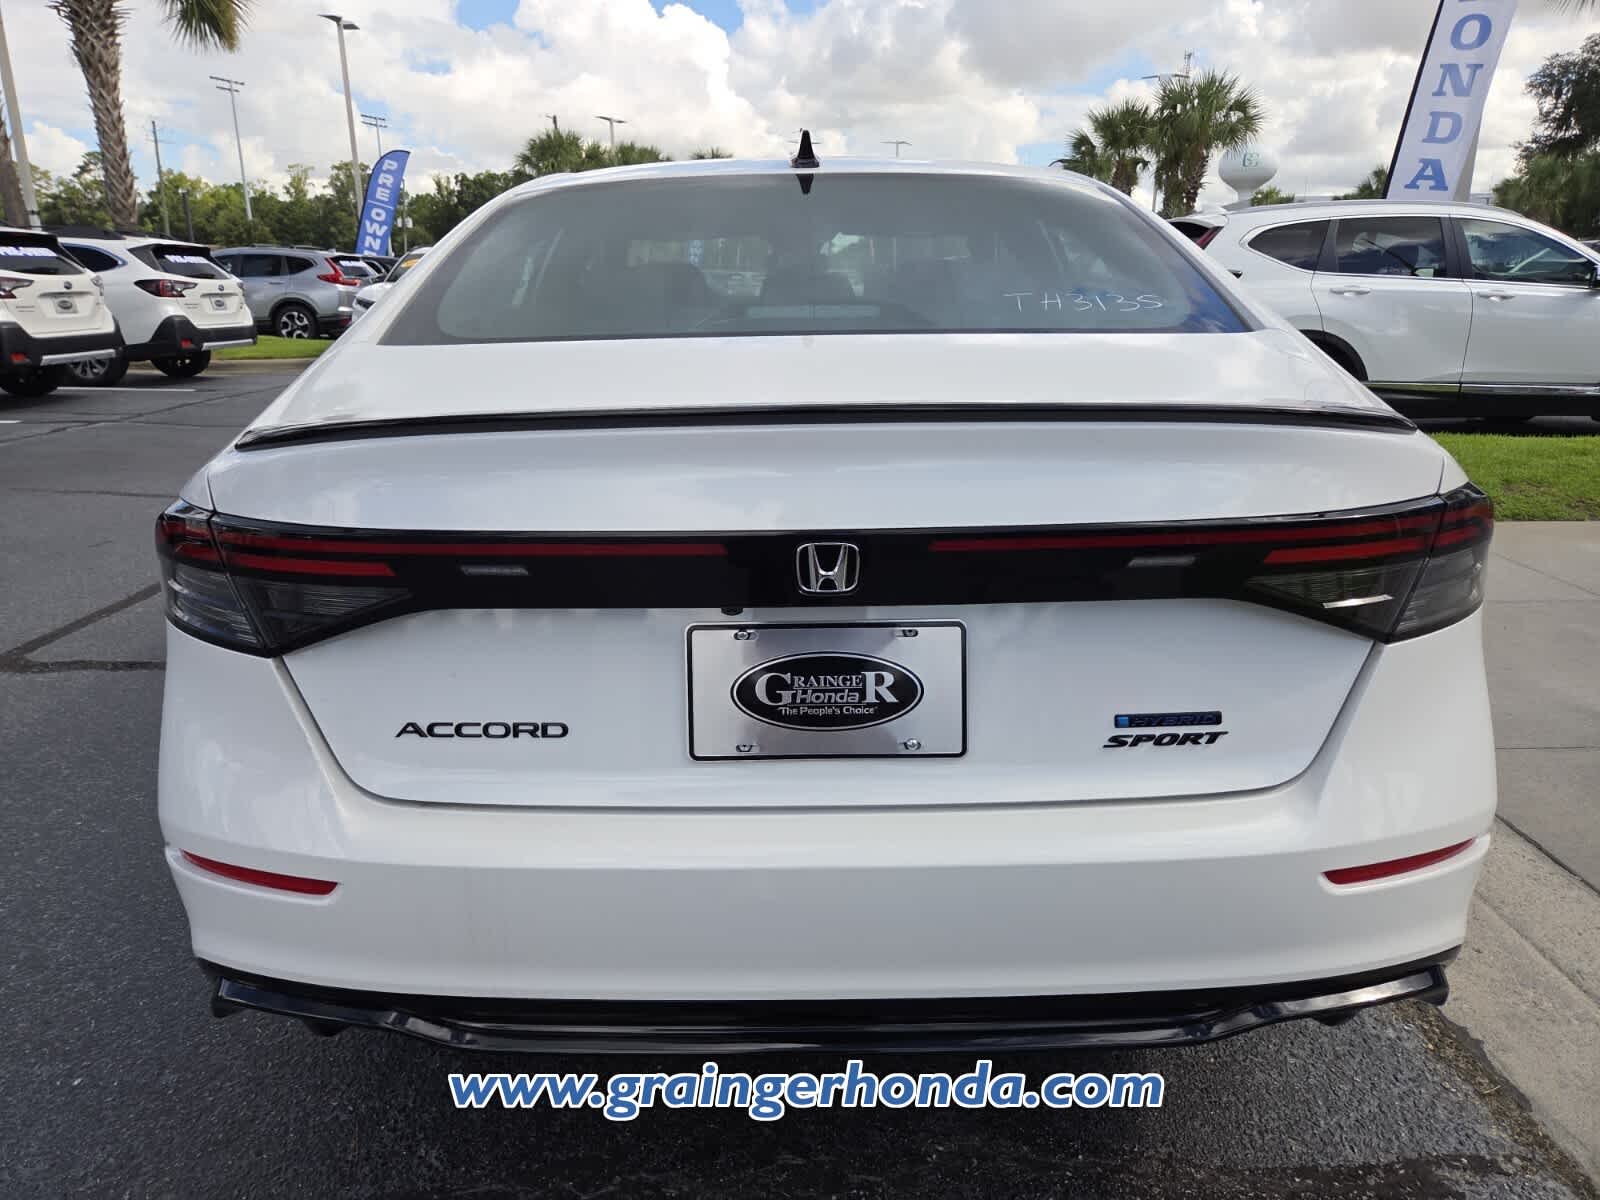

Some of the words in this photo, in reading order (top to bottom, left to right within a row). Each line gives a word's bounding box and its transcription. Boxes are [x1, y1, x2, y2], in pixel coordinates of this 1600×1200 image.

[1404, 0, 1492, 191] ONDA
[754, 671, 899, 706] GRAINGER
[795, 689, 860, 704] Honda
[800, 706, 841, 717] People's
[395, 721, 569, 739] ACCORD
[1102, 731, 1229, 748] SPORT
